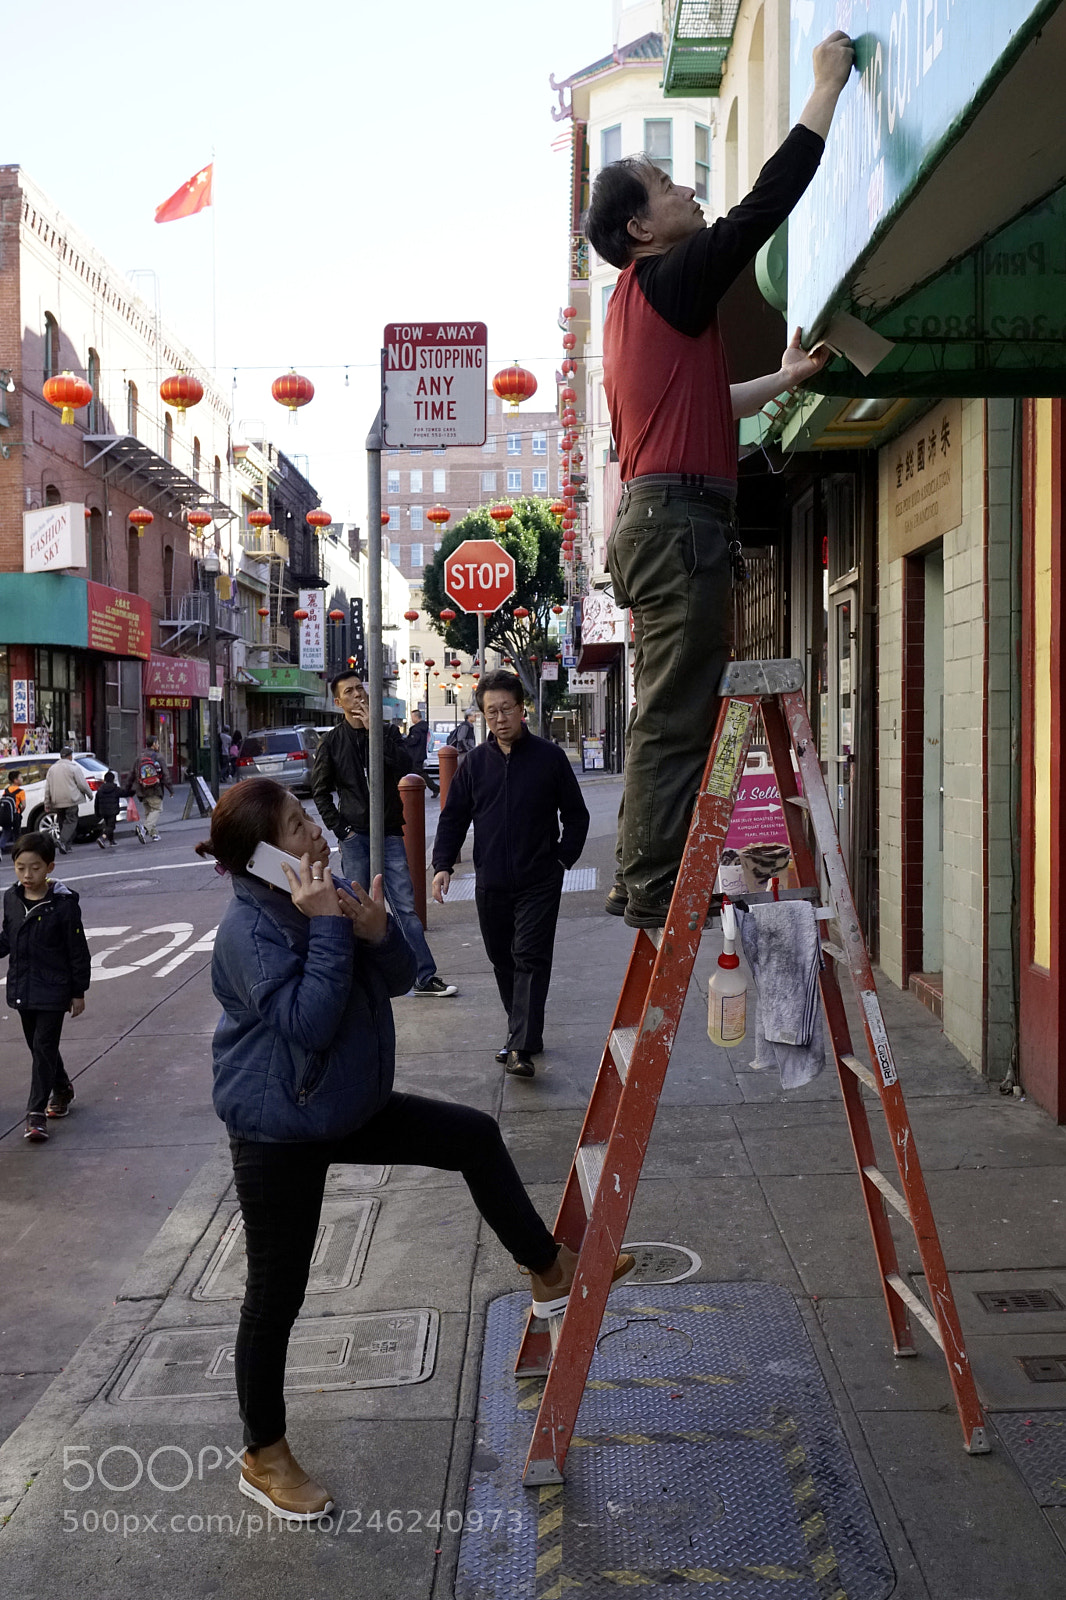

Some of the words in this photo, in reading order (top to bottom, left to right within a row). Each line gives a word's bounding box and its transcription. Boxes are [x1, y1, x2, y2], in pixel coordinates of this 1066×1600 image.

[389, 343, 414, 370] NO
[420, 349, 482, 369] STOPPING
[416, 376, 454, 396] ANY
[413, 401, 457, 420] TIME
[30, 512, 67, 559] FASHION
[44, 539, 60, 566] SKY
[450, 563, 510, 590] STOP
